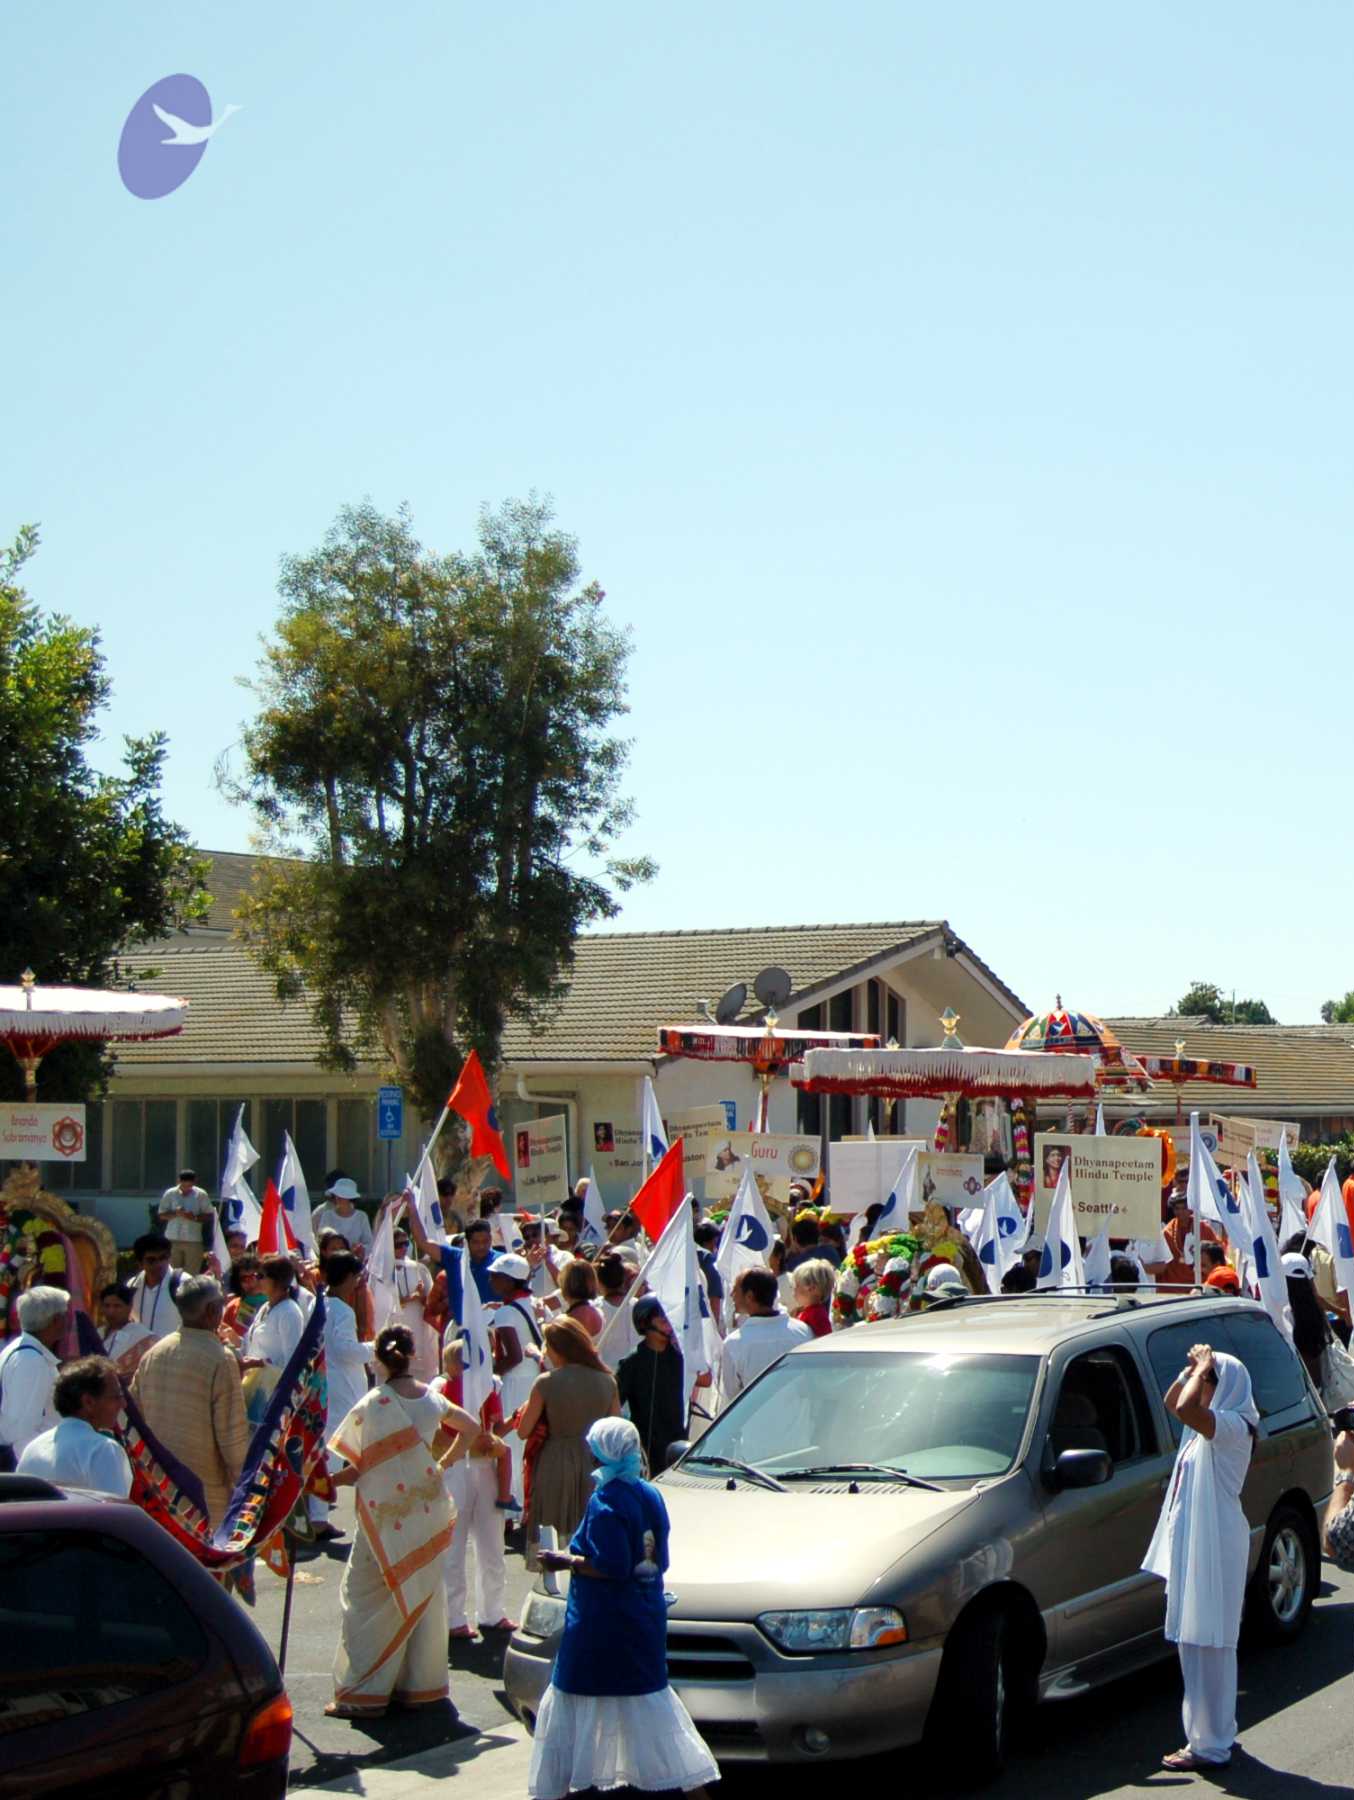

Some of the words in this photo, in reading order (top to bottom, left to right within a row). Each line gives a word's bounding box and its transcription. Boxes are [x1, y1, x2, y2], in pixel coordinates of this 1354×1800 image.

[751, 1140, 779, 1160] Guru
[1073, 1156, 1155, 1170] Dhyanapeetam
[1074, 1168, 1110, 1180] Hindu
[1112, 1170, 1154, 1182] Temple
